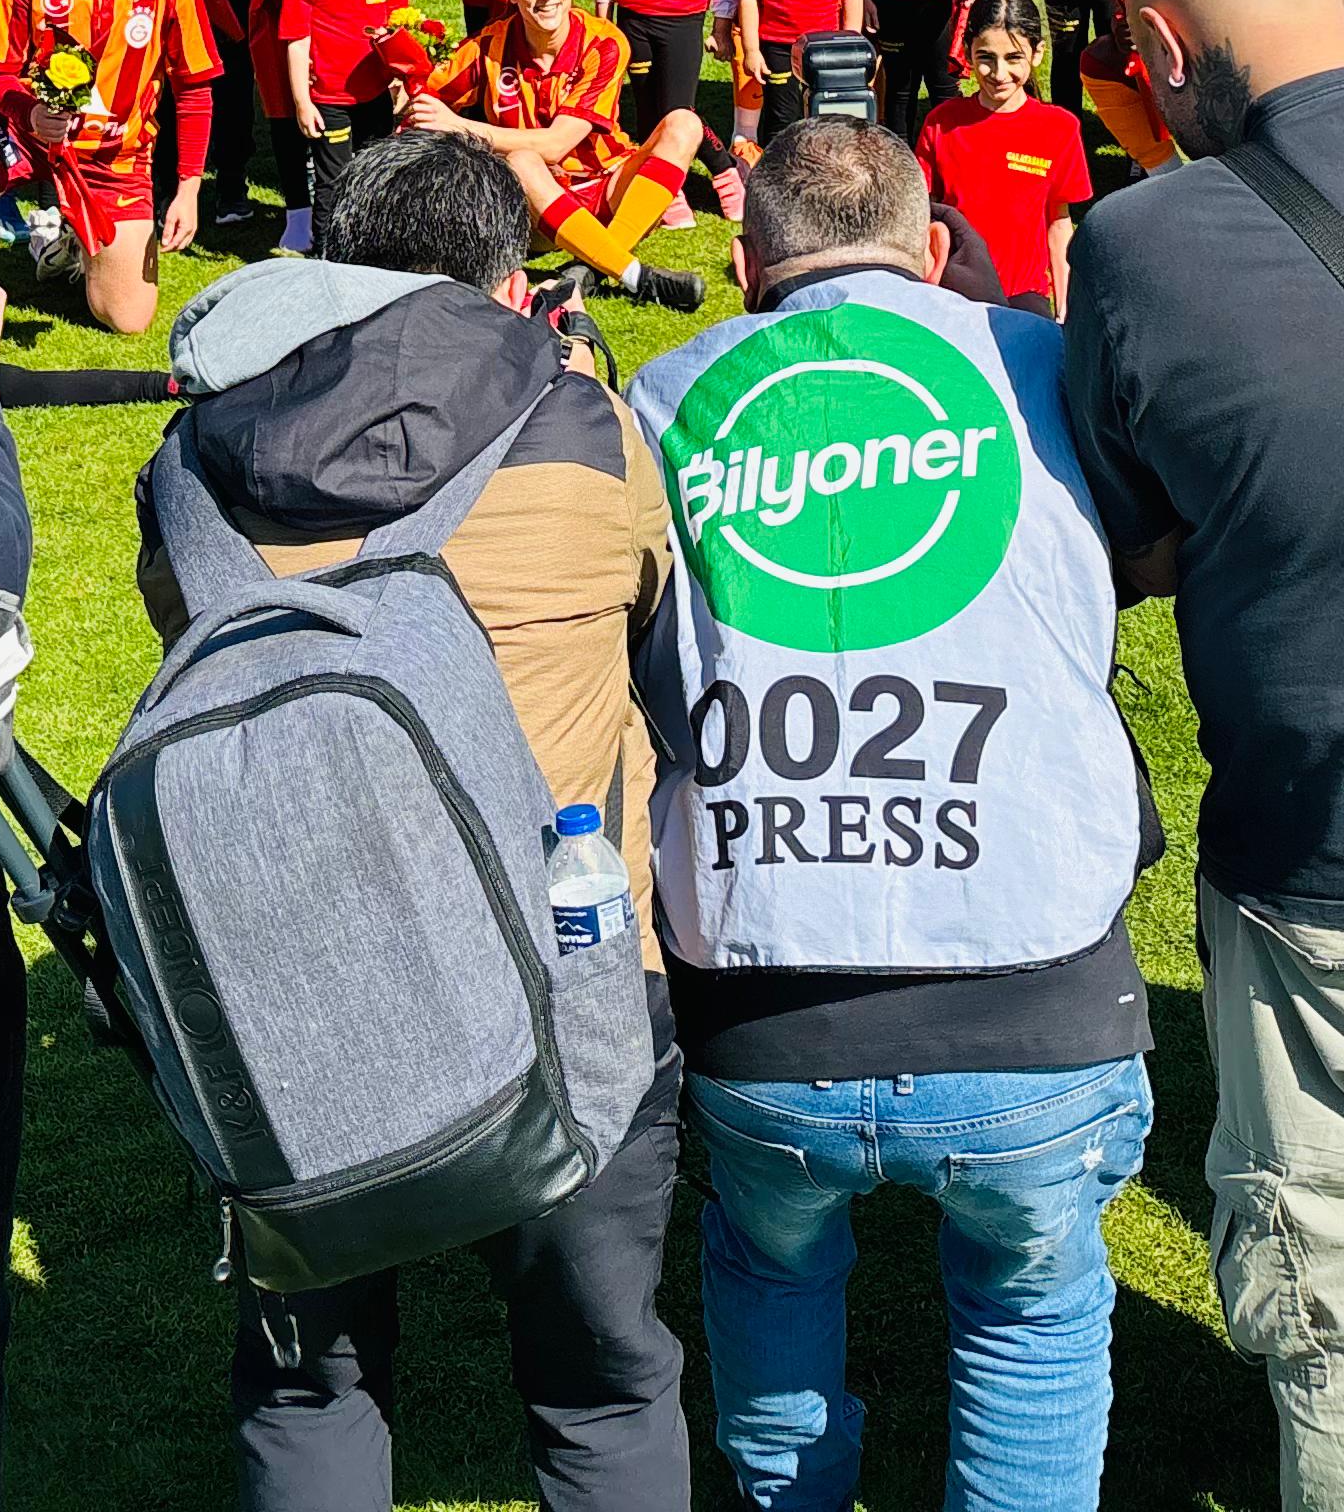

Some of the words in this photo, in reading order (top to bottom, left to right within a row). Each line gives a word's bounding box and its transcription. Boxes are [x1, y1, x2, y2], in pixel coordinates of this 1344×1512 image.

[1006, 151, 1052, 169] GALATASARAY
[678, 426, 997, 548] Bilyoner
[690, 674, 1007, 787] 0027
[706, 795, 980, 871] PRESS
[136, 858, 229, 1057] CONCEPT
